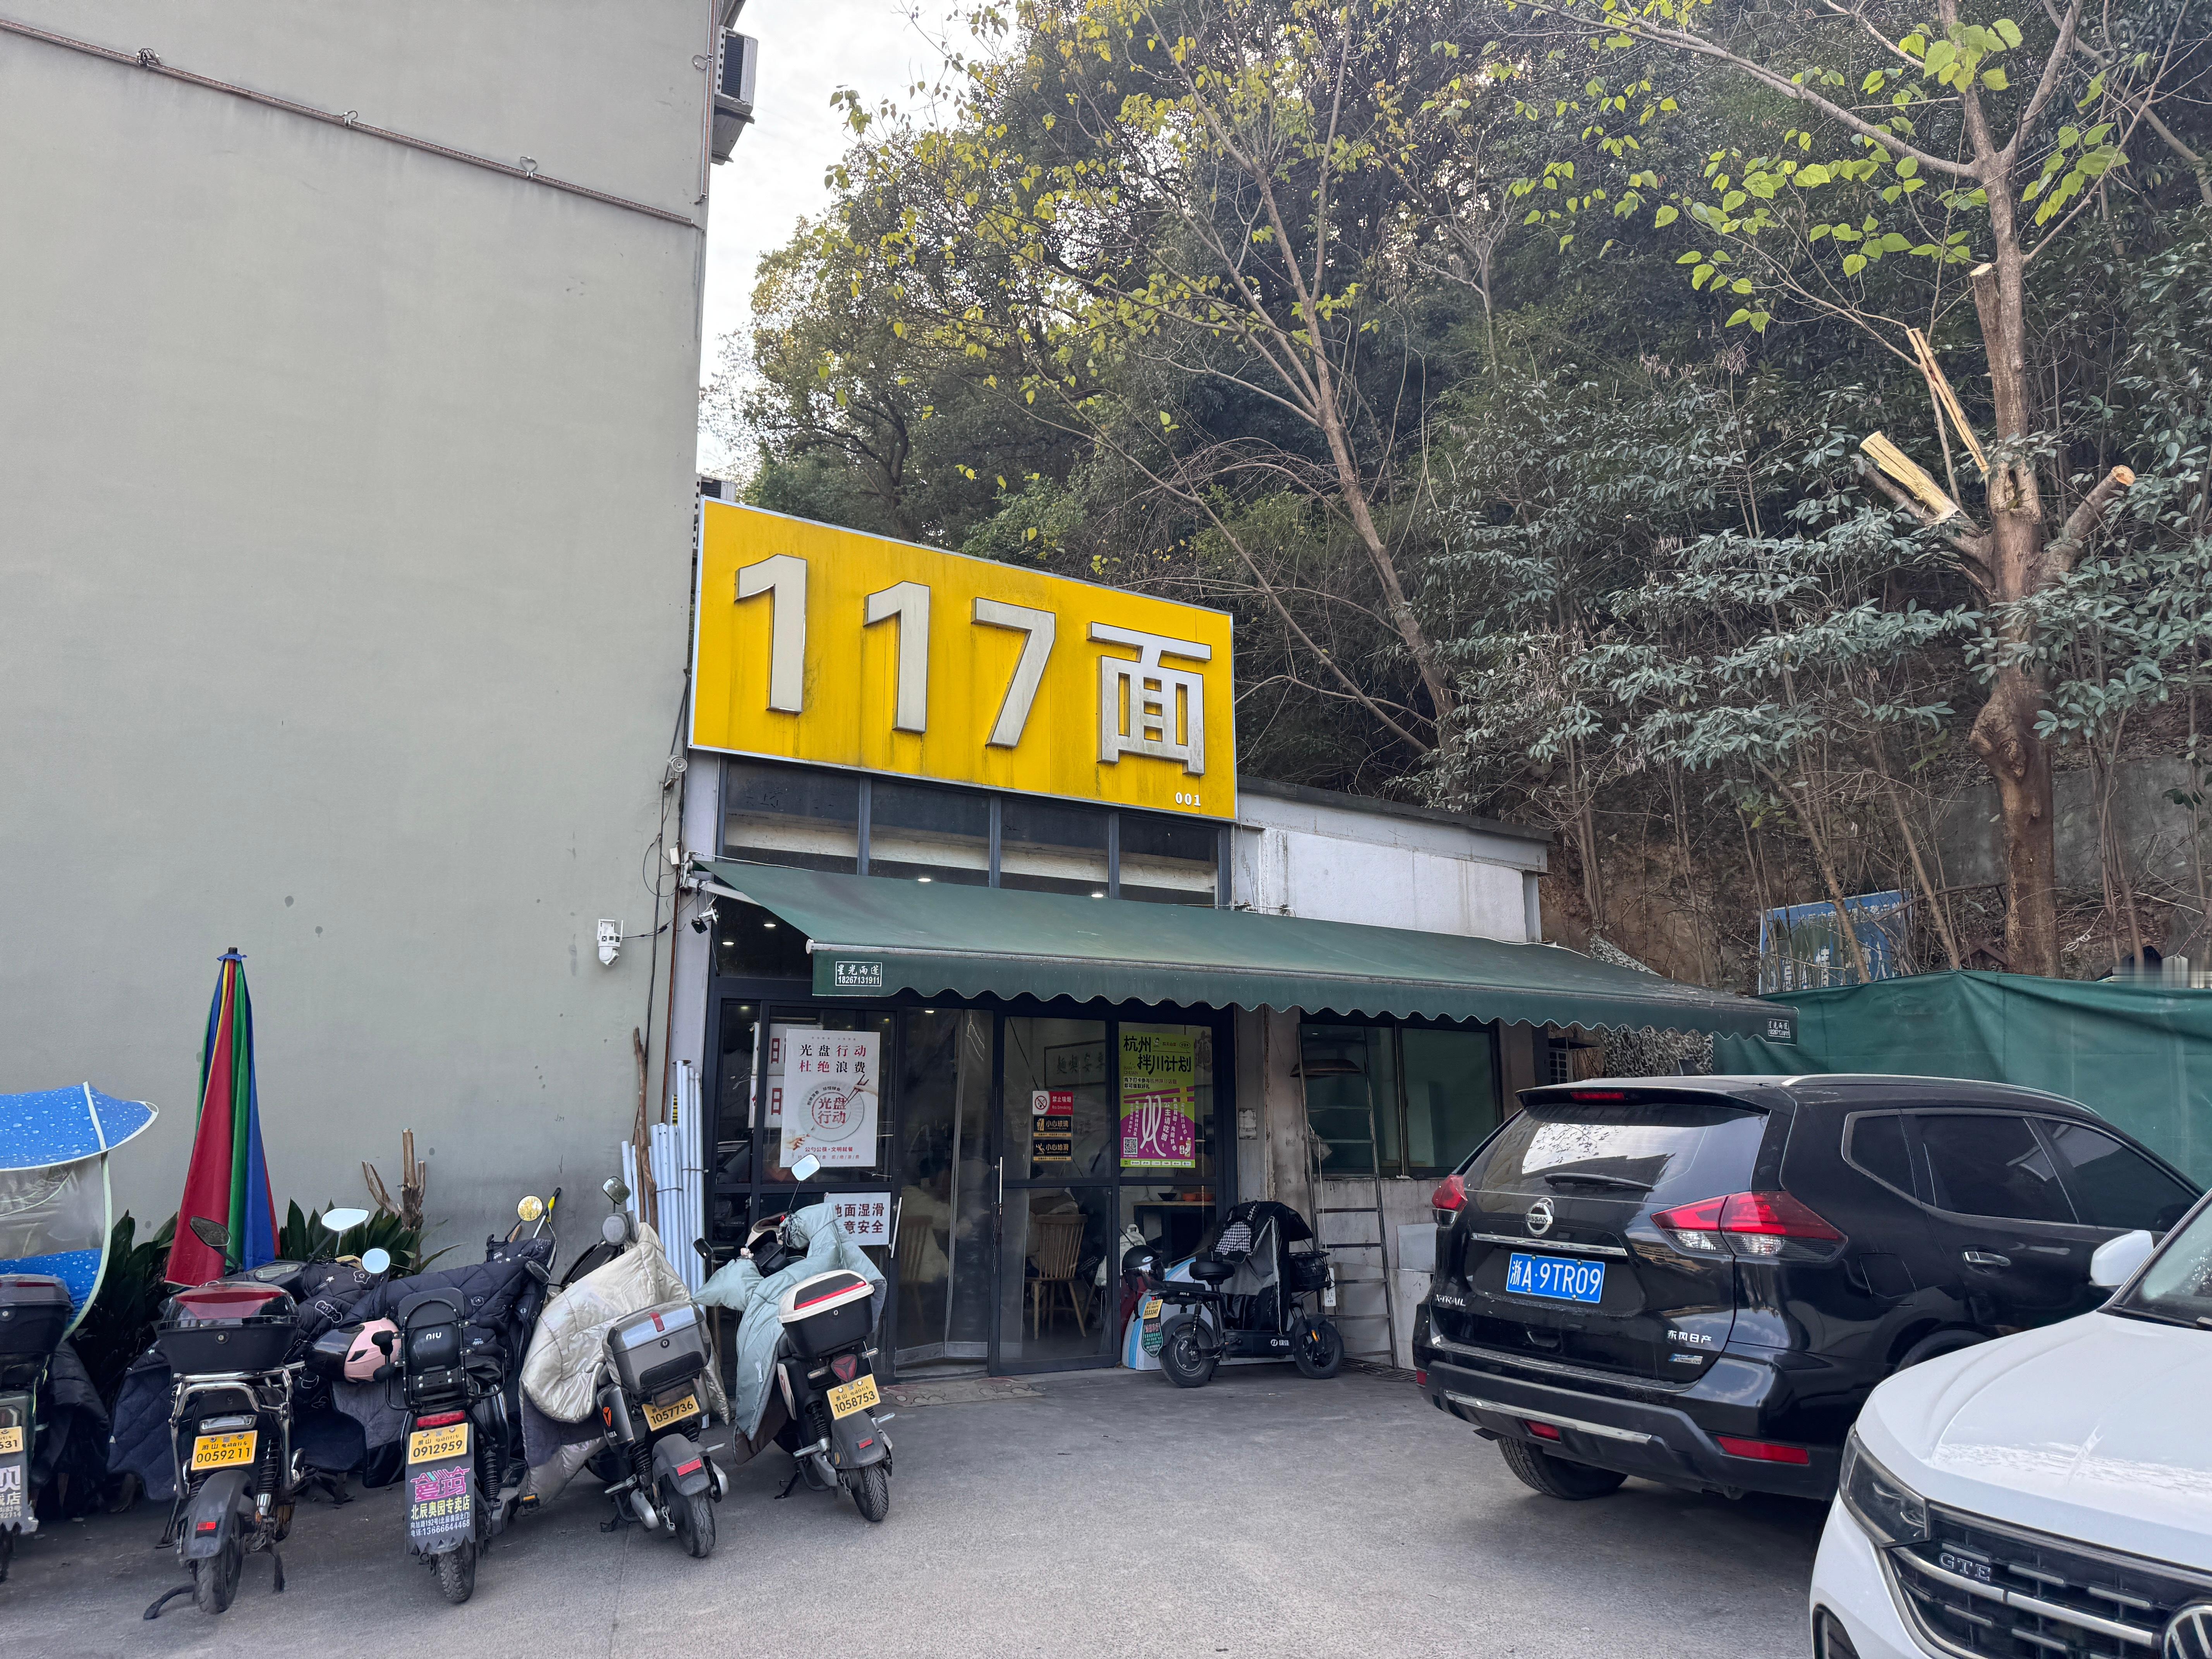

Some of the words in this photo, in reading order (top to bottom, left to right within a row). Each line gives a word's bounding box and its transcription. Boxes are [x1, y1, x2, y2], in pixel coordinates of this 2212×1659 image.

[1175, 792, 1201, 806] 001
[838, 975, 879, 984] 18267131911
[799, 1044, 866, 1057] 光盘行动
[1123, 1035, 1151, 1053] 杭州
[799, 1060, 866, 1073] 杜绝浪费
[1137, 1053, 1191, 1075] 拌川计划
[1526, 1214, 1548, 1223] NISSAN
[843, 1219, 884, 1234] 意安全
[1667, 1330, 1712, 1344] 东风日产
[835, 1391, 875, 1413] 1058753
[651, 1401, 694, 1424] 1057736
[197, 1448, 250, 1463] 0059211
[413, 1440, 462, 1457] 0912959
[411, 1494, 470, 1520] 北辰奥园专卖店
[1939, 1553, 1990, 1581] GTE
